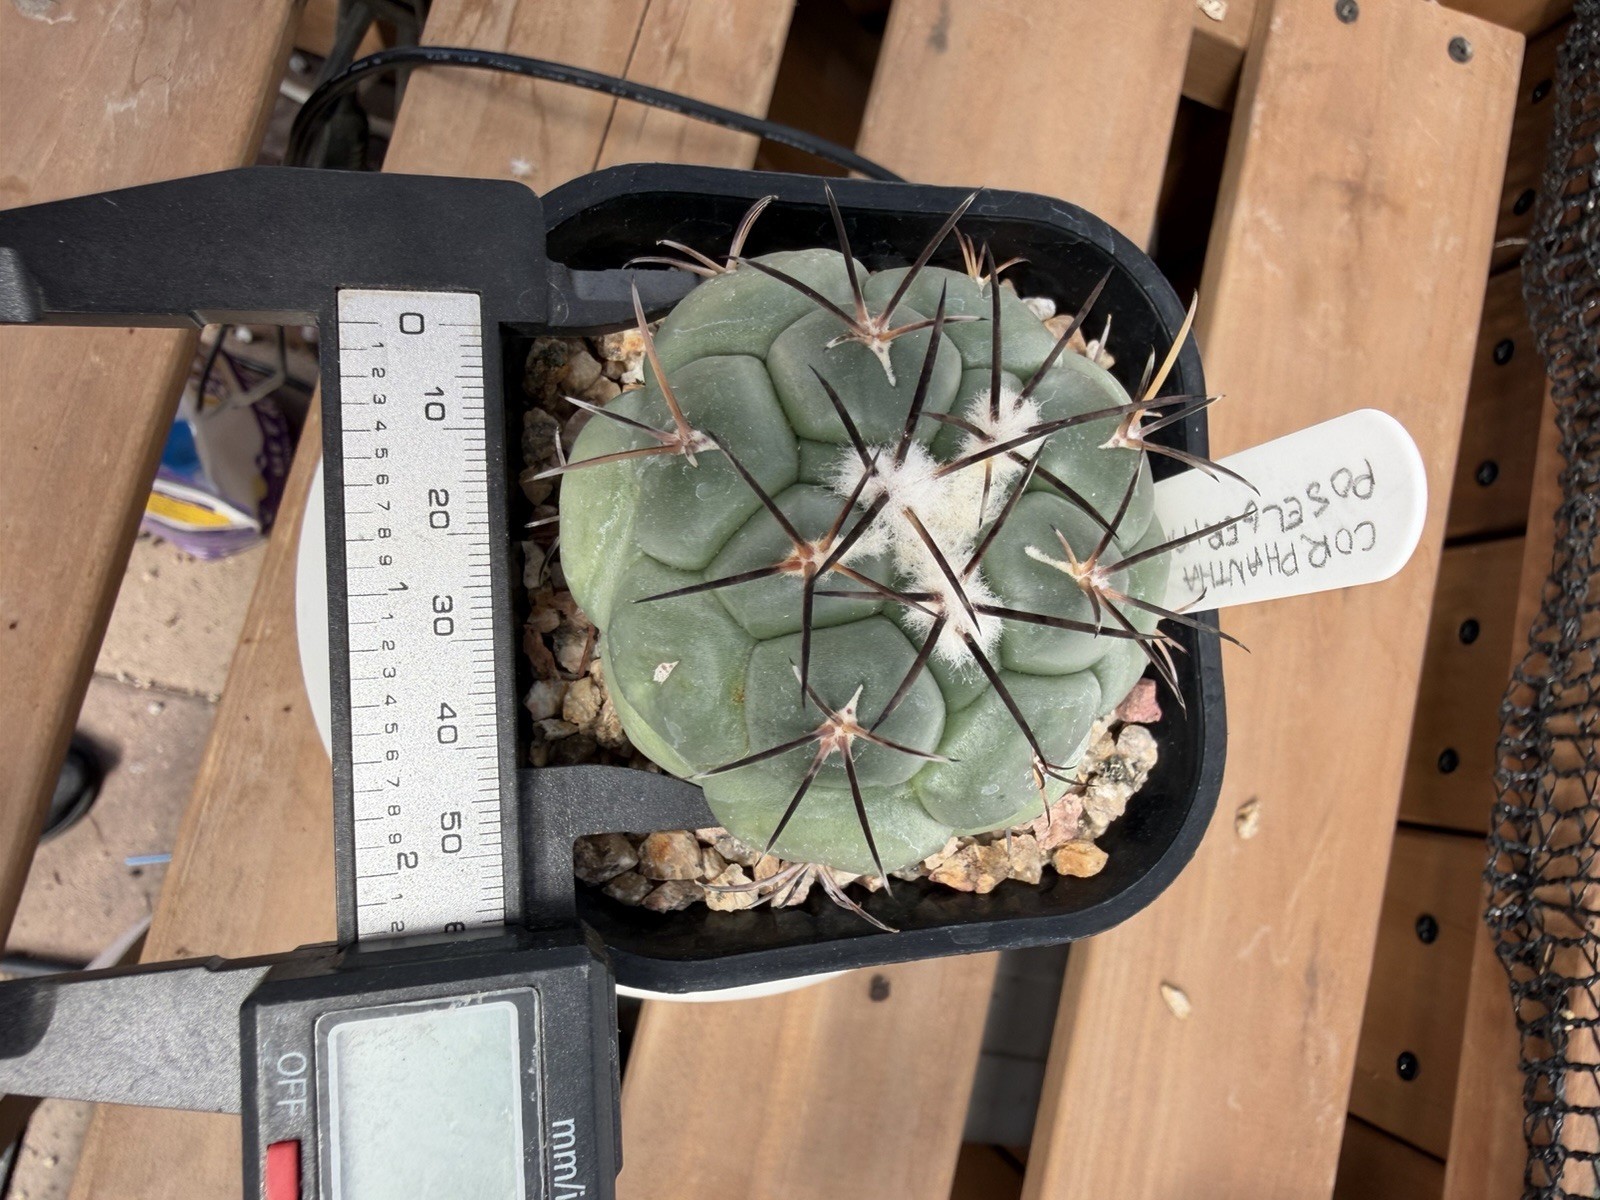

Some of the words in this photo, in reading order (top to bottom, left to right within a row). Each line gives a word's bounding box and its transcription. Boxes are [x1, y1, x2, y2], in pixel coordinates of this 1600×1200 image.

[399, 312, 425, 335] 0
[372, 367, 386, 378] 2
[373, 394, 387, 405] 3
[424, 386, 446, 421] 10
[375, 420, 388, 432] 4
[375, 447, 389, 459] 5
[376, 474, 390, 485] 6
[377, 500, 391, 511] 7
[428, 488, 450, 529] 20
[378, 527, 392, 538] 8
[379, 555, 393, 566] 9
[388, 582, 409, 591] 1
[432, 595, 454, 636] 30
[382, 640, 396, 651] 2
[383, 667, 397, 678] 3
[384, 694, 397, 706] 4
[385, 722, 399, 734] 5
[437, 702, 458, 744] 40
[386, 750, 400, 761] 6
[386, 776, 400, 788] 7
[388, 805, 401, 816] 8
[440, 811, 462, 853] 50
[388, 833, 402, 844] 9
[397, 851, 419, 870] 2
[391, 920, 405, 933] 2
[276, 1052, 307, 1116] OFF
